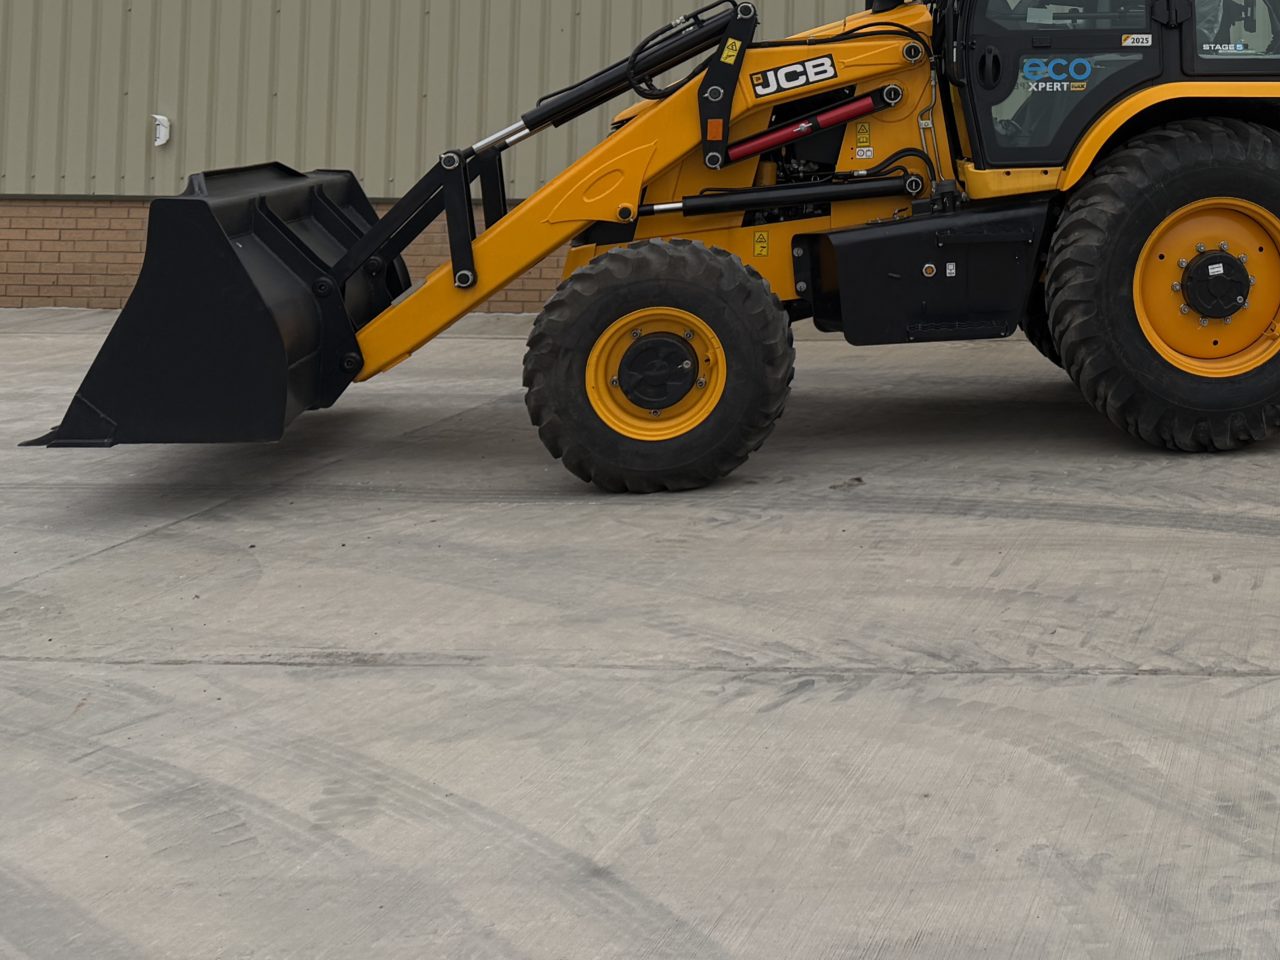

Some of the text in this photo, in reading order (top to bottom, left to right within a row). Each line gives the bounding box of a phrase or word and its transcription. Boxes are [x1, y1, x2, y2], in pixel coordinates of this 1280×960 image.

[754, 57, 835, 95] JCB
[1023, 58, 1092, 80] eco
[1028, 82, 1069, 92] XPERT
